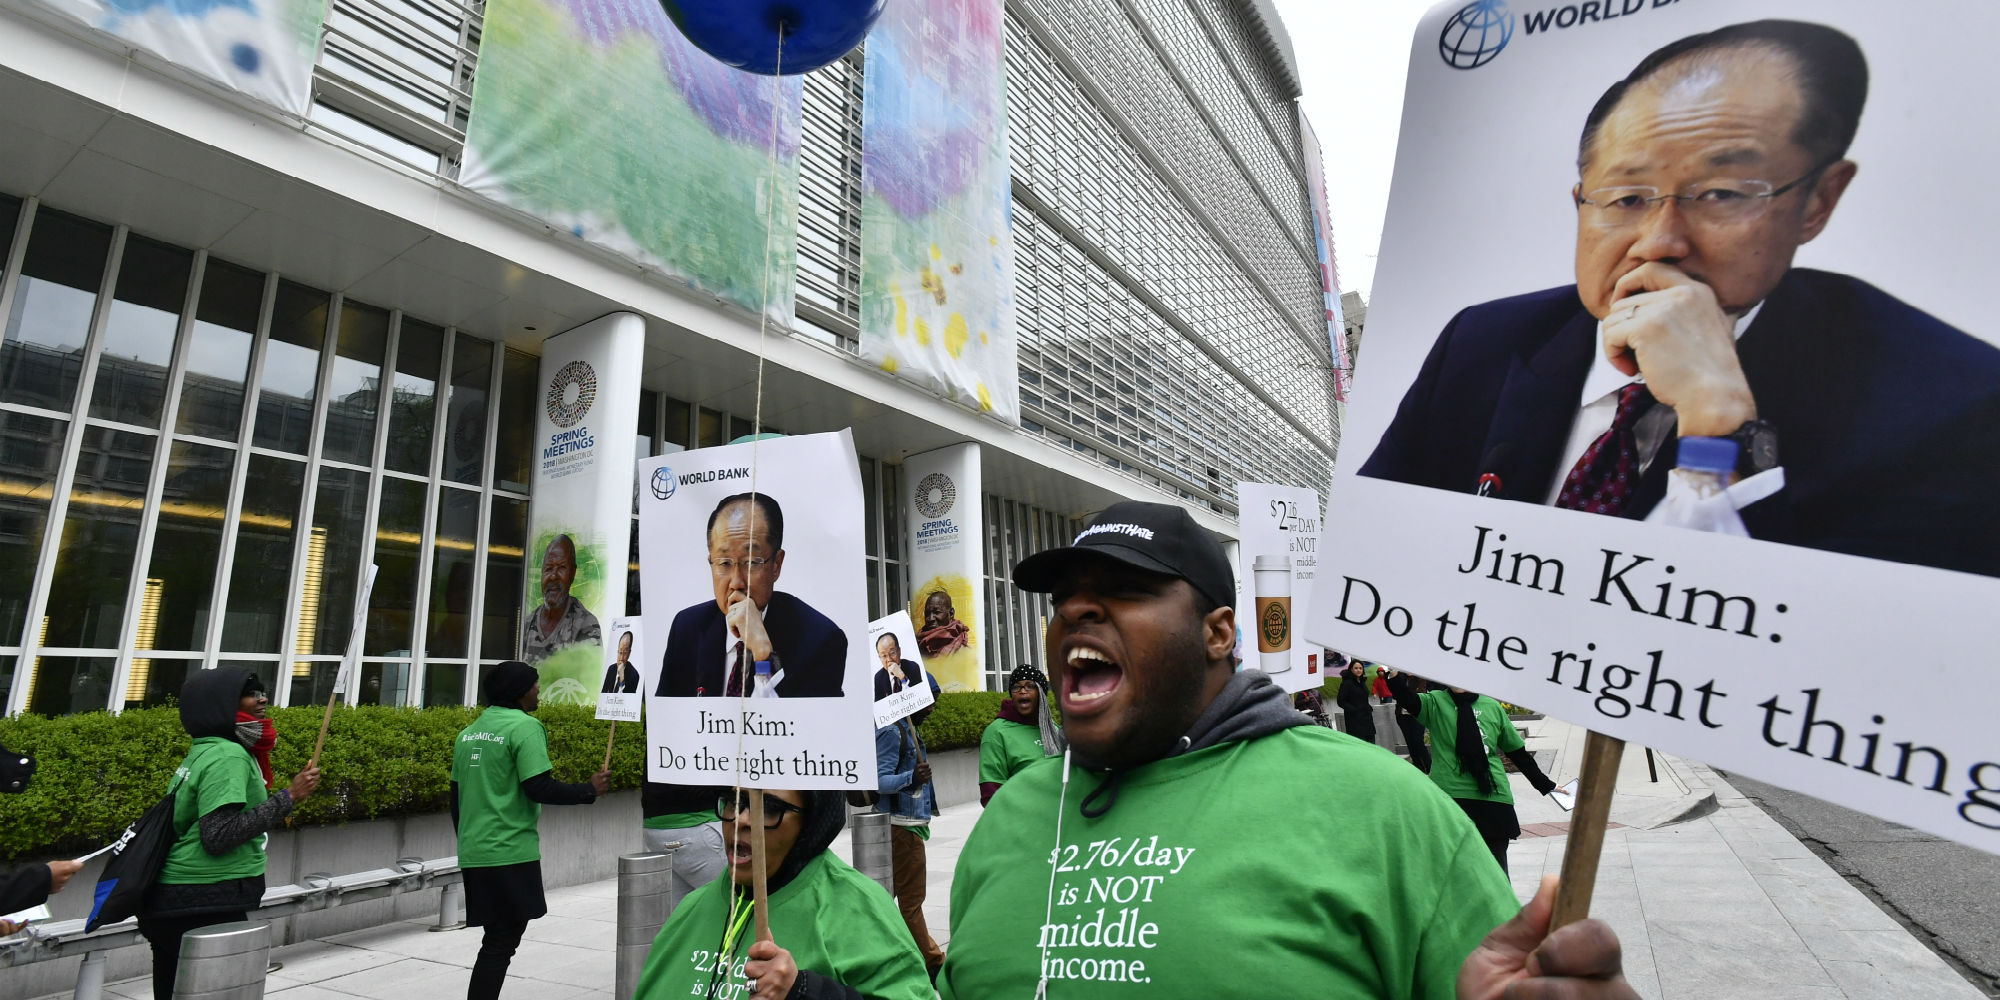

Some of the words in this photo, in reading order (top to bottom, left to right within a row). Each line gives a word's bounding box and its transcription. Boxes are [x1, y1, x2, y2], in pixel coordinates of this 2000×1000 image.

[1523, 0, 1643, 35] WORLD
[544, 436, 594, 459] MEETINGS
[551, 427, 587, 445] SPRING
[679, 471, 716, 486] WORLD
[718, 468, 750, 480] BANK
[917, 526, 959, 539] MEETINGS
[922, 519, 952, 531] SPRING
[1298, 518, 1315, 533] DAY
[1289, 539, 1295, 552] is
[1296, 537, 1316, 552] NOT
[1296, 556, 1316, 567] middle
[1296, 569, 1314, 580] incom
[1458, 526, 1566, 596] Jim
[1590, 549, 1789, 643] Kim:
[1334, 576, 1414, 637] Do
[1435, 603, 1528, 671] the
[1545, 643, 1728, 729] right
[1756, 688, 2000, 830] thing
[697, 710, 735, 735] Jim
[742, 711, 795, 737] Kim:
[659, 746, 686, 770] Do
[693, 746, 729, 772] the
[735, 748, 785, 781] right
[792, 749, 859, 784] thing
[1048, 835, 1196, 874] $2.76/day
[1057, 882, 1079, 906] is
[1084, 875, 1164, 904] NOT
[1036, 907, 1159, 948] middle
[1040, 951, 1151, 984] income.
[691, 979, 704, 996] is
